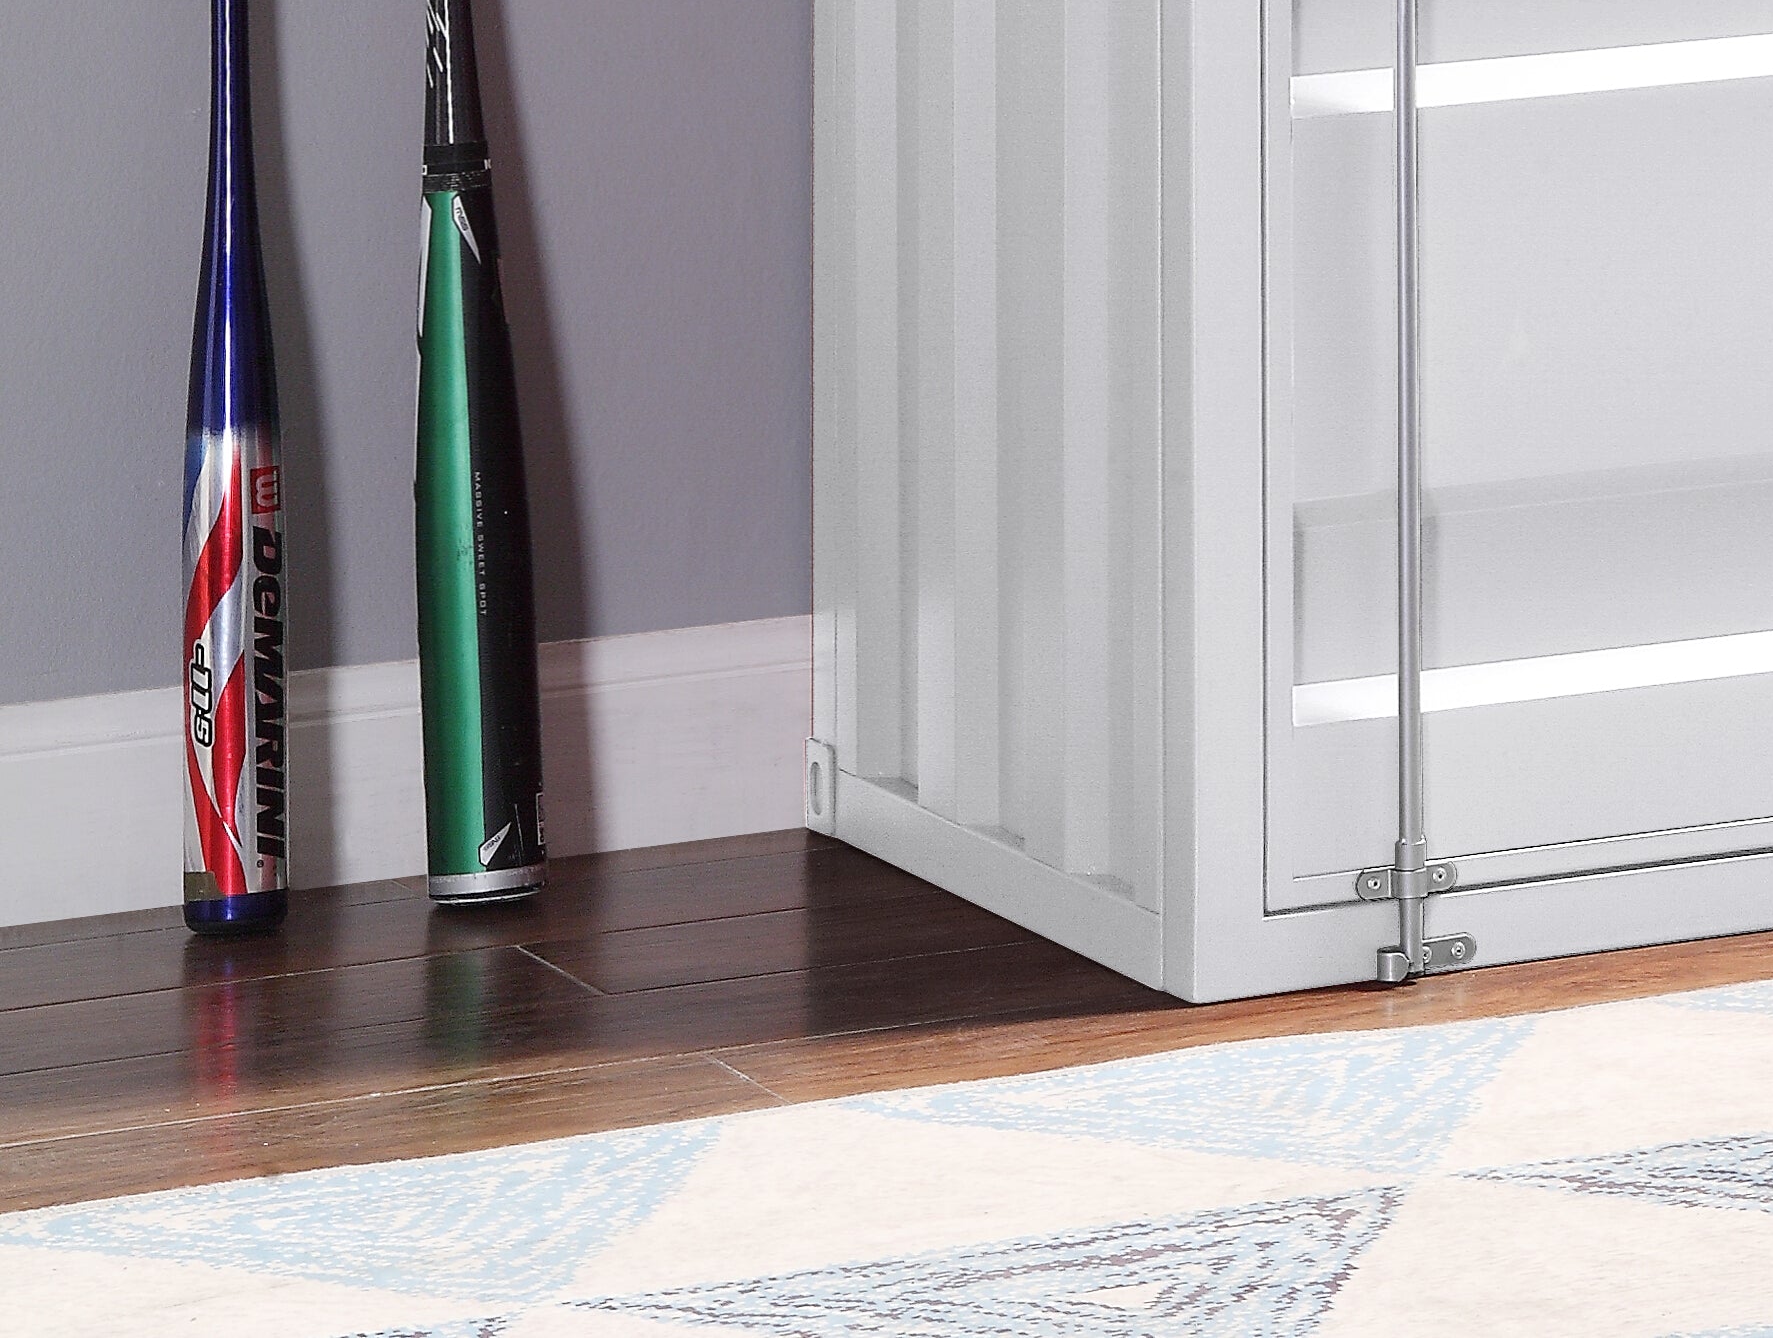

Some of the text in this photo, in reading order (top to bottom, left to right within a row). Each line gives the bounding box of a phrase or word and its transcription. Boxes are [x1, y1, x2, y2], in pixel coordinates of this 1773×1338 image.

[474, 471, 487, 617] MASSIVE SWEET SPOT
